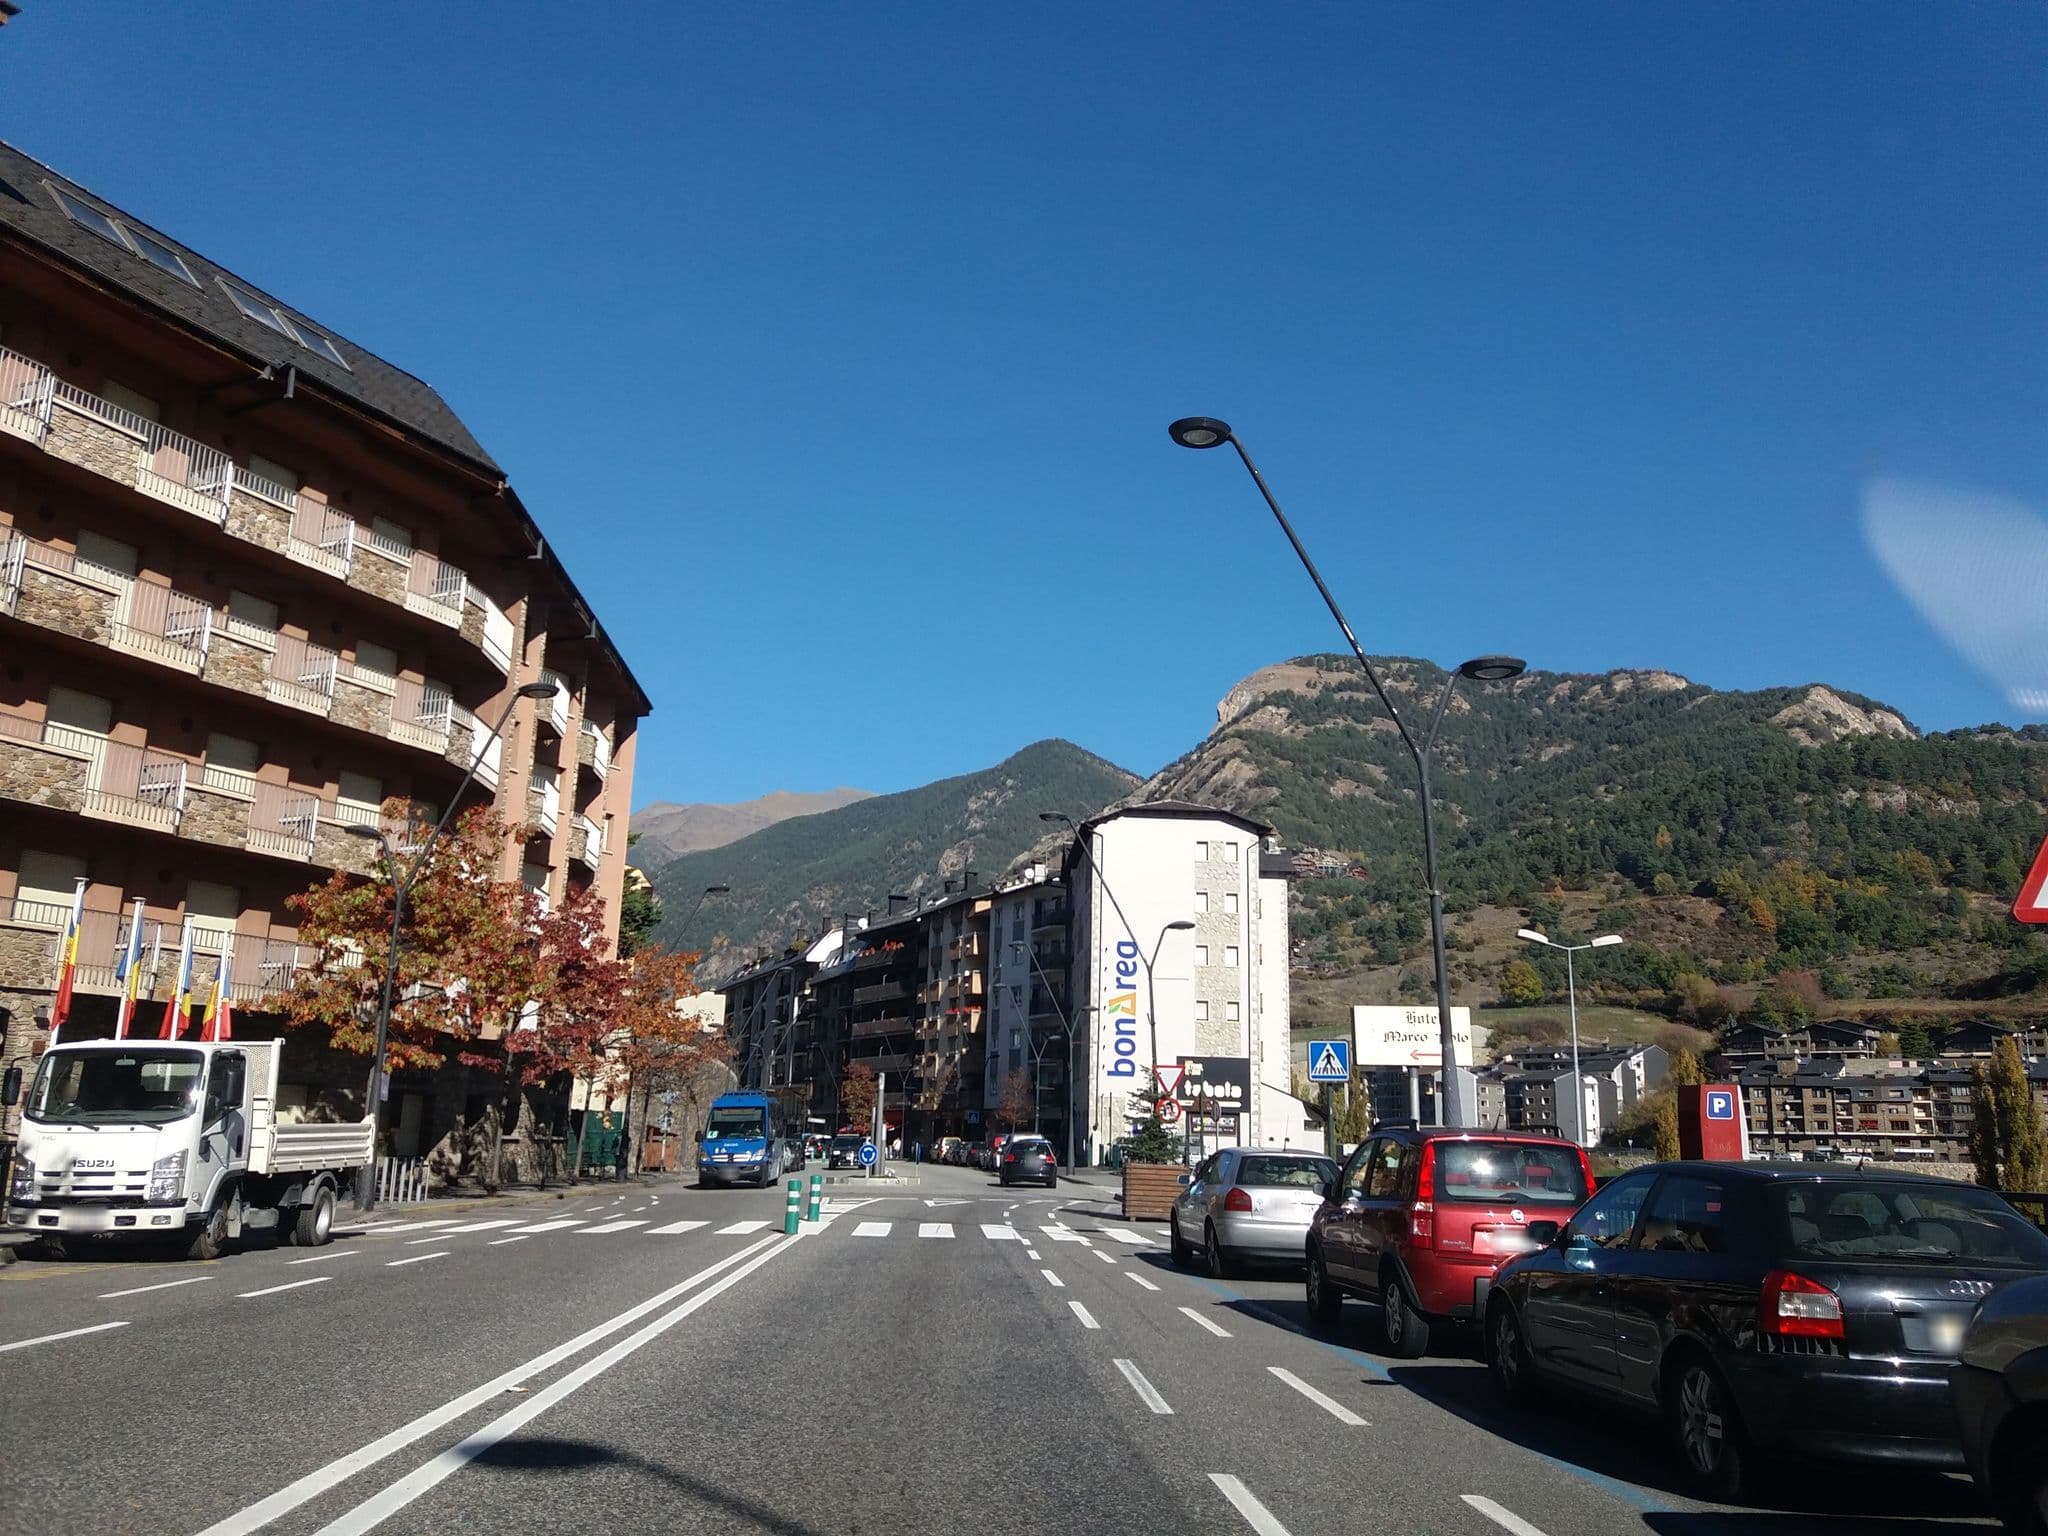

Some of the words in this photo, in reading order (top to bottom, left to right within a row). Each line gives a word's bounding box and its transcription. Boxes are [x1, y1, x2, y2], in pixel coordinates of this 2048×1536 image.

[1406, 1011, 1441, 1026] Hote
[1384, 1031, 1428, 1043] Marco
[1713, 1097, 1726, 1114] P
[73, 1159, 115, 1168] ISUZU
